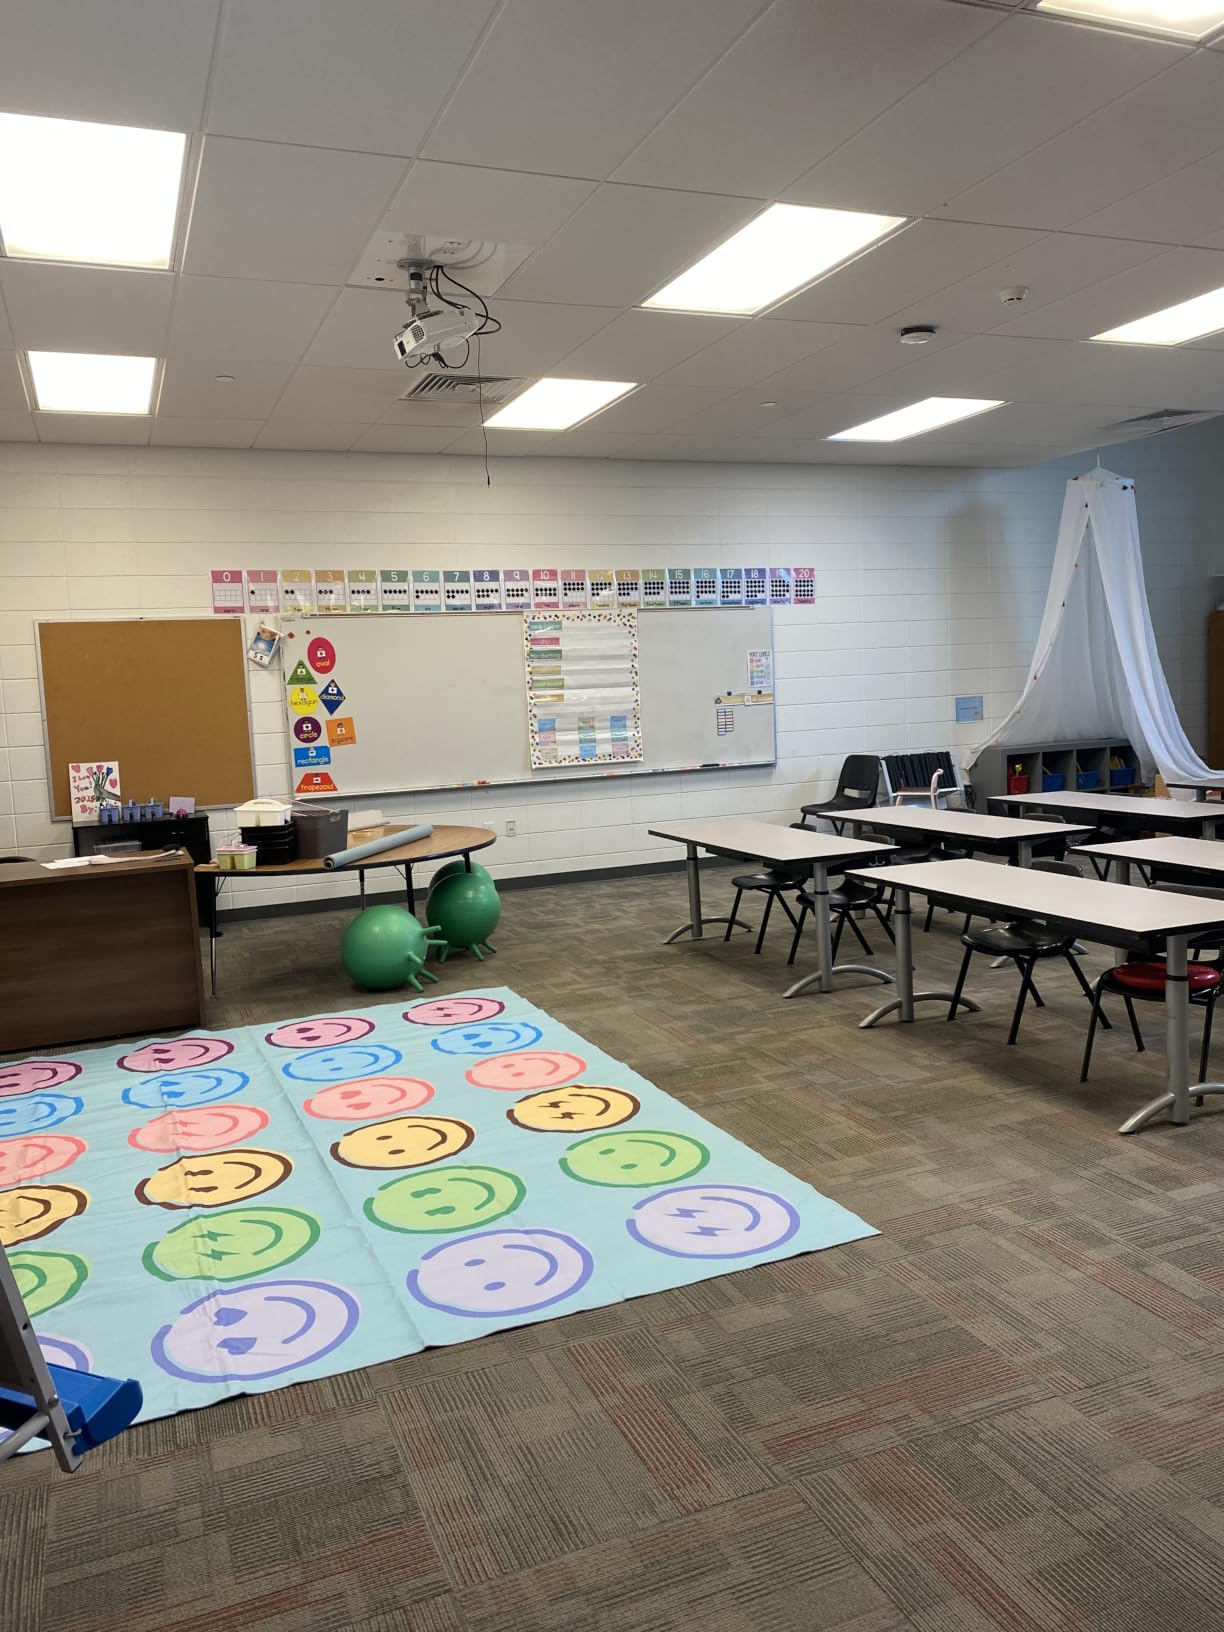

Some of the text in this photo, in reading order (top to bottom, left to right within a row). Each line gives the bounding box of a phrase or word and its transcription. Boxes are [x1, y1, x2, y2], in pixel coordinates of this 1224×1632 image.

[222, 571, 231, 582] 0
[293, 571, 302, 582] 2
[327, 571, 333, 582] 3
[358, 571, 366, 582] 4
[391, 571, 398, 582] 5
[422, 571, 430, 582] 6
[453, 571, 460, 581] 7
[483, 571, 490, 581] 8
[513, 570, 520, 580] 9
[540, 570, 550, 580] 10
[597, 570, 605, 580] 12
[623, 570, 631, 581] 13
[649, 570, 657, 580] 14
[675, 569, 683, 579] 15
[701, 569, 709, 578] 16
[727, 569, 735, 578] 17
[751, 569, 758, 578] 18
[776, 569, 784, 578] 19
[799, 569, 810, 578] 20
[315, 660, 331, 668] oval
[290, 697, 319, 706] hexagon
[299, 731, 318, 739] circle
[331, 735, 353, 745] square
[297, 755, 329, 765] rectangle
[300, 783, 334, 792] trapezoid
[74, 795, 96, 804] 2025
